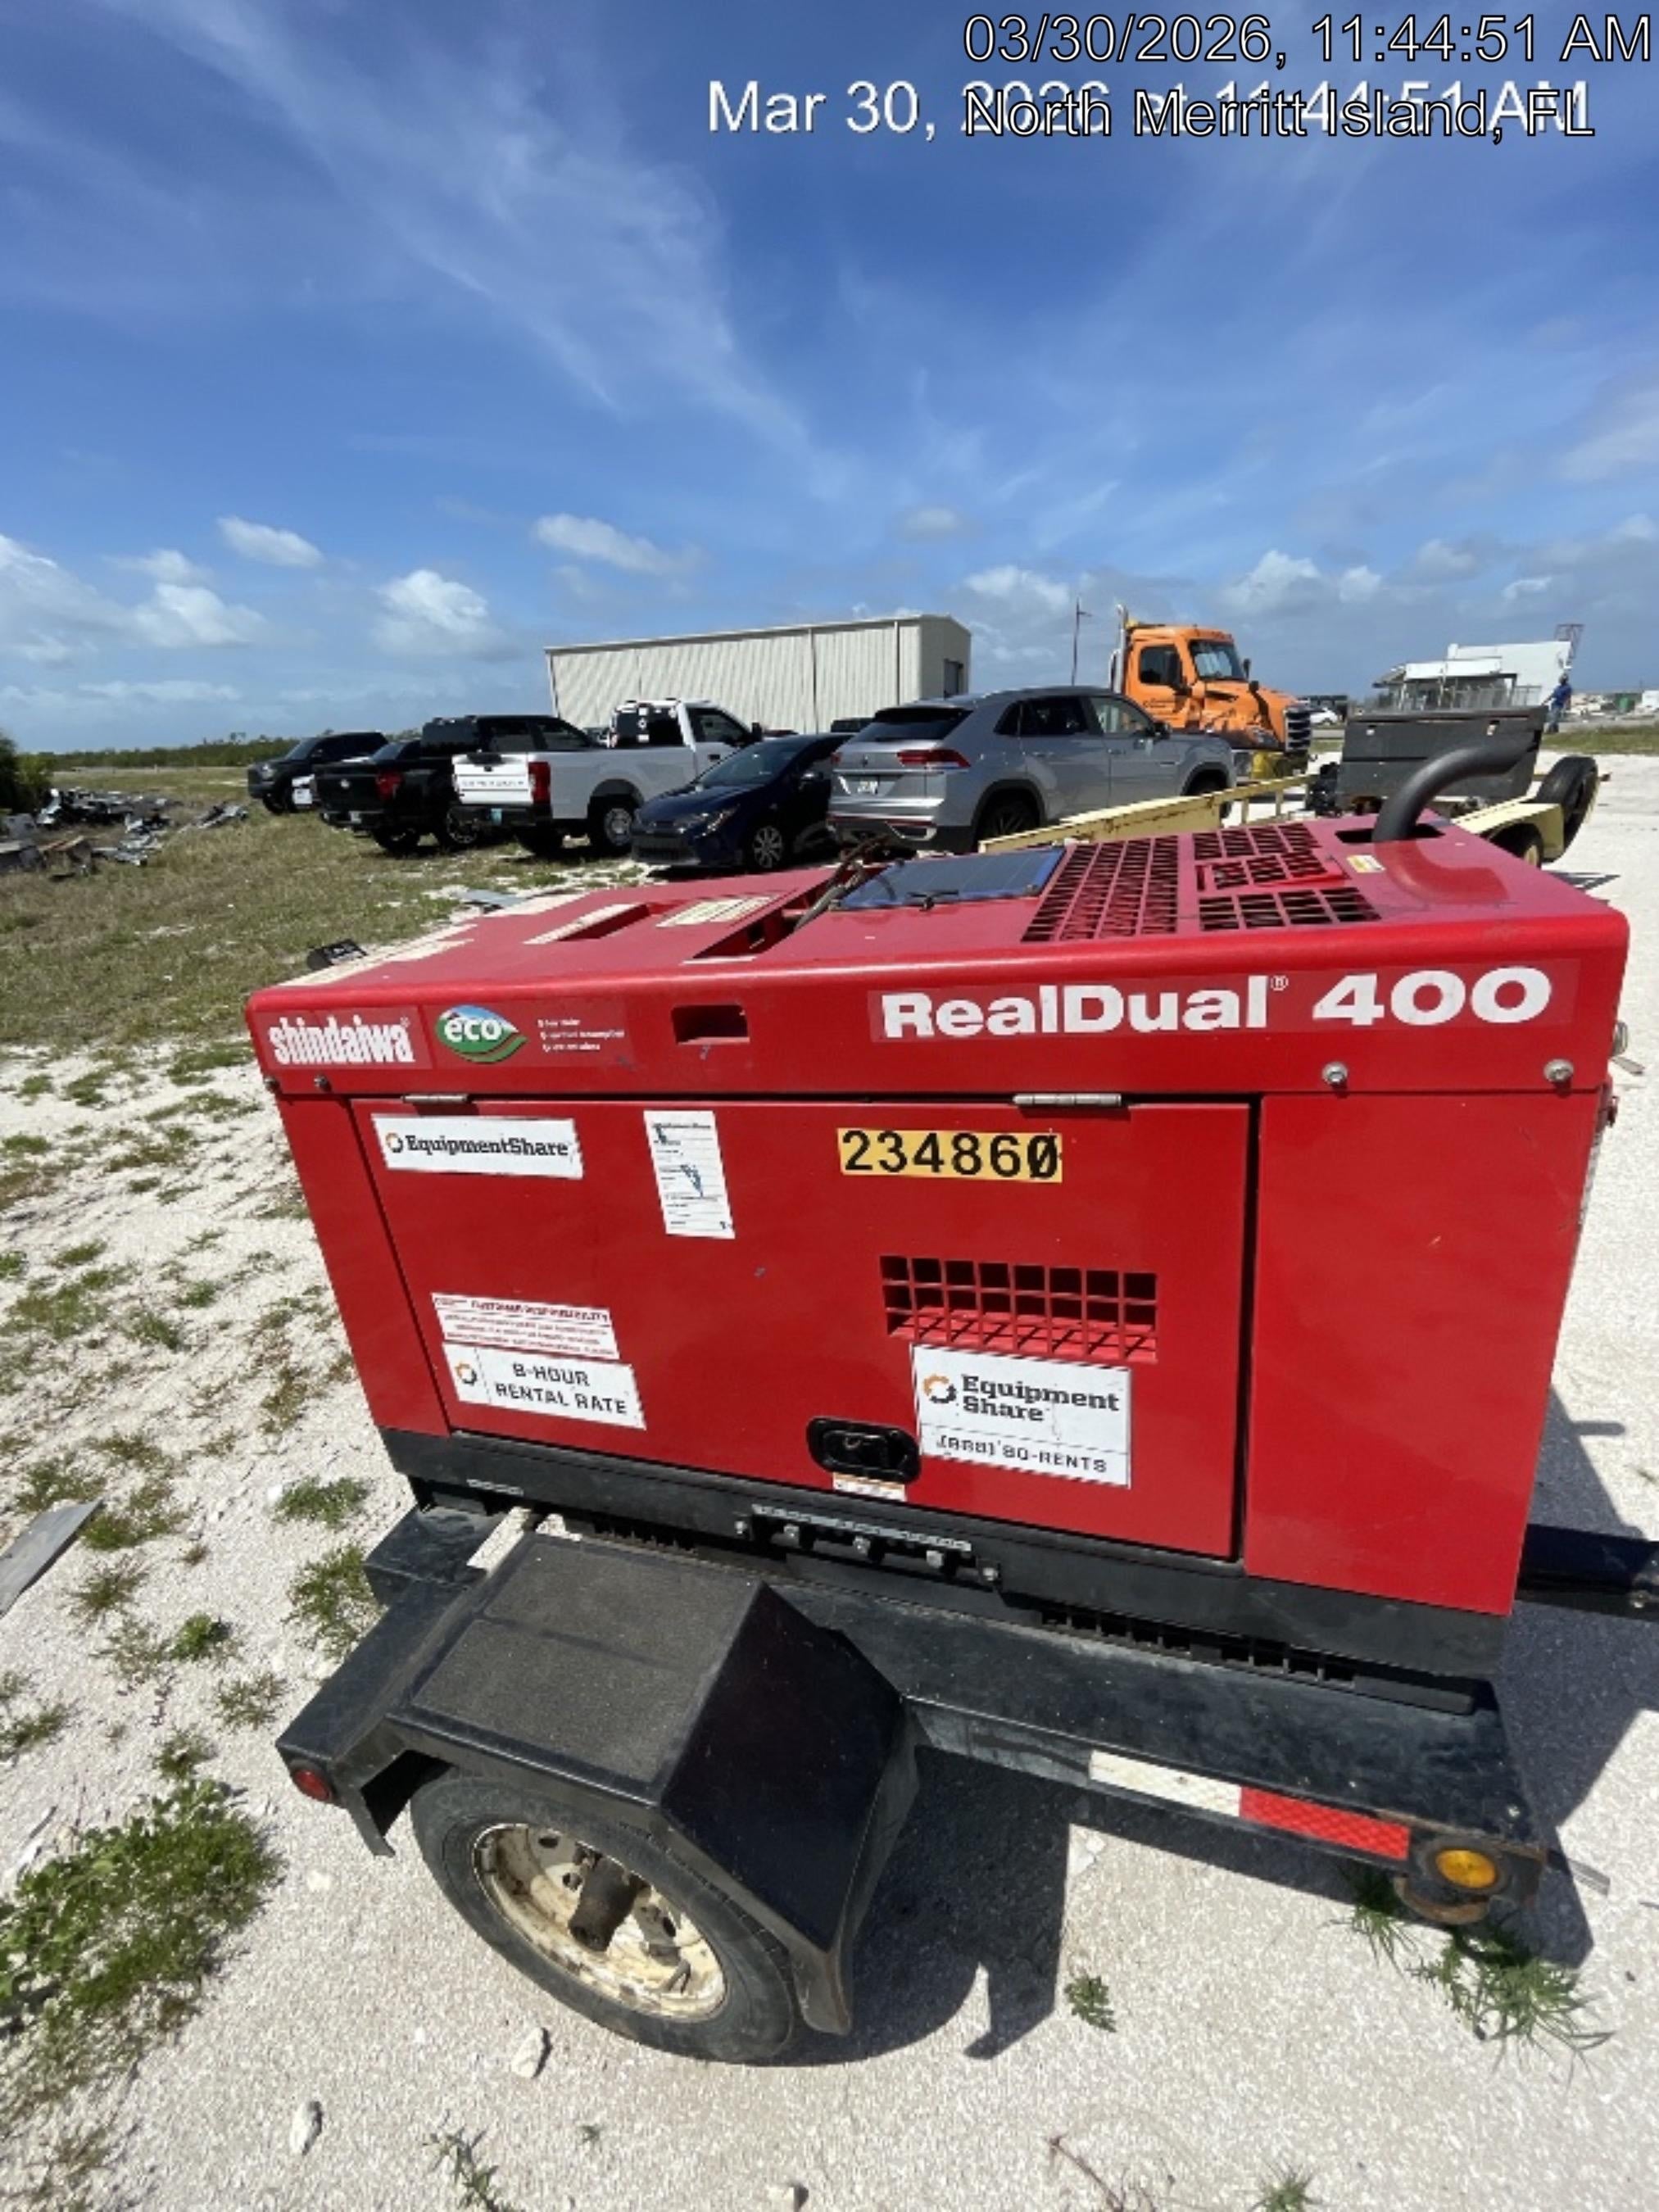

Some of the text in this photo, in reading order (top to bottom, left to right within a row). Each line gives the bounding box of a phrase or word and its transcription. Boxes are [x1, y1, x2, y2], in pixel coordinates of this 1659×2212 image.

[1312, 967, 1552, 1026] 400
[270, 1014, 416, 1064] shindaiwa
[444, 1018, 503, 1042] eco
[405, 1135, 569, 1156] EquipmentShare
[842, 1130, 1058, 1178] 234860
[513, 1362, 590, 1387] 8-HOUR
[495, 1382, 628, 1415] RENTAL RATE
[961, 1373, 1120, 1412] Equipment
[962, 1395, 1045, 1422] Share
